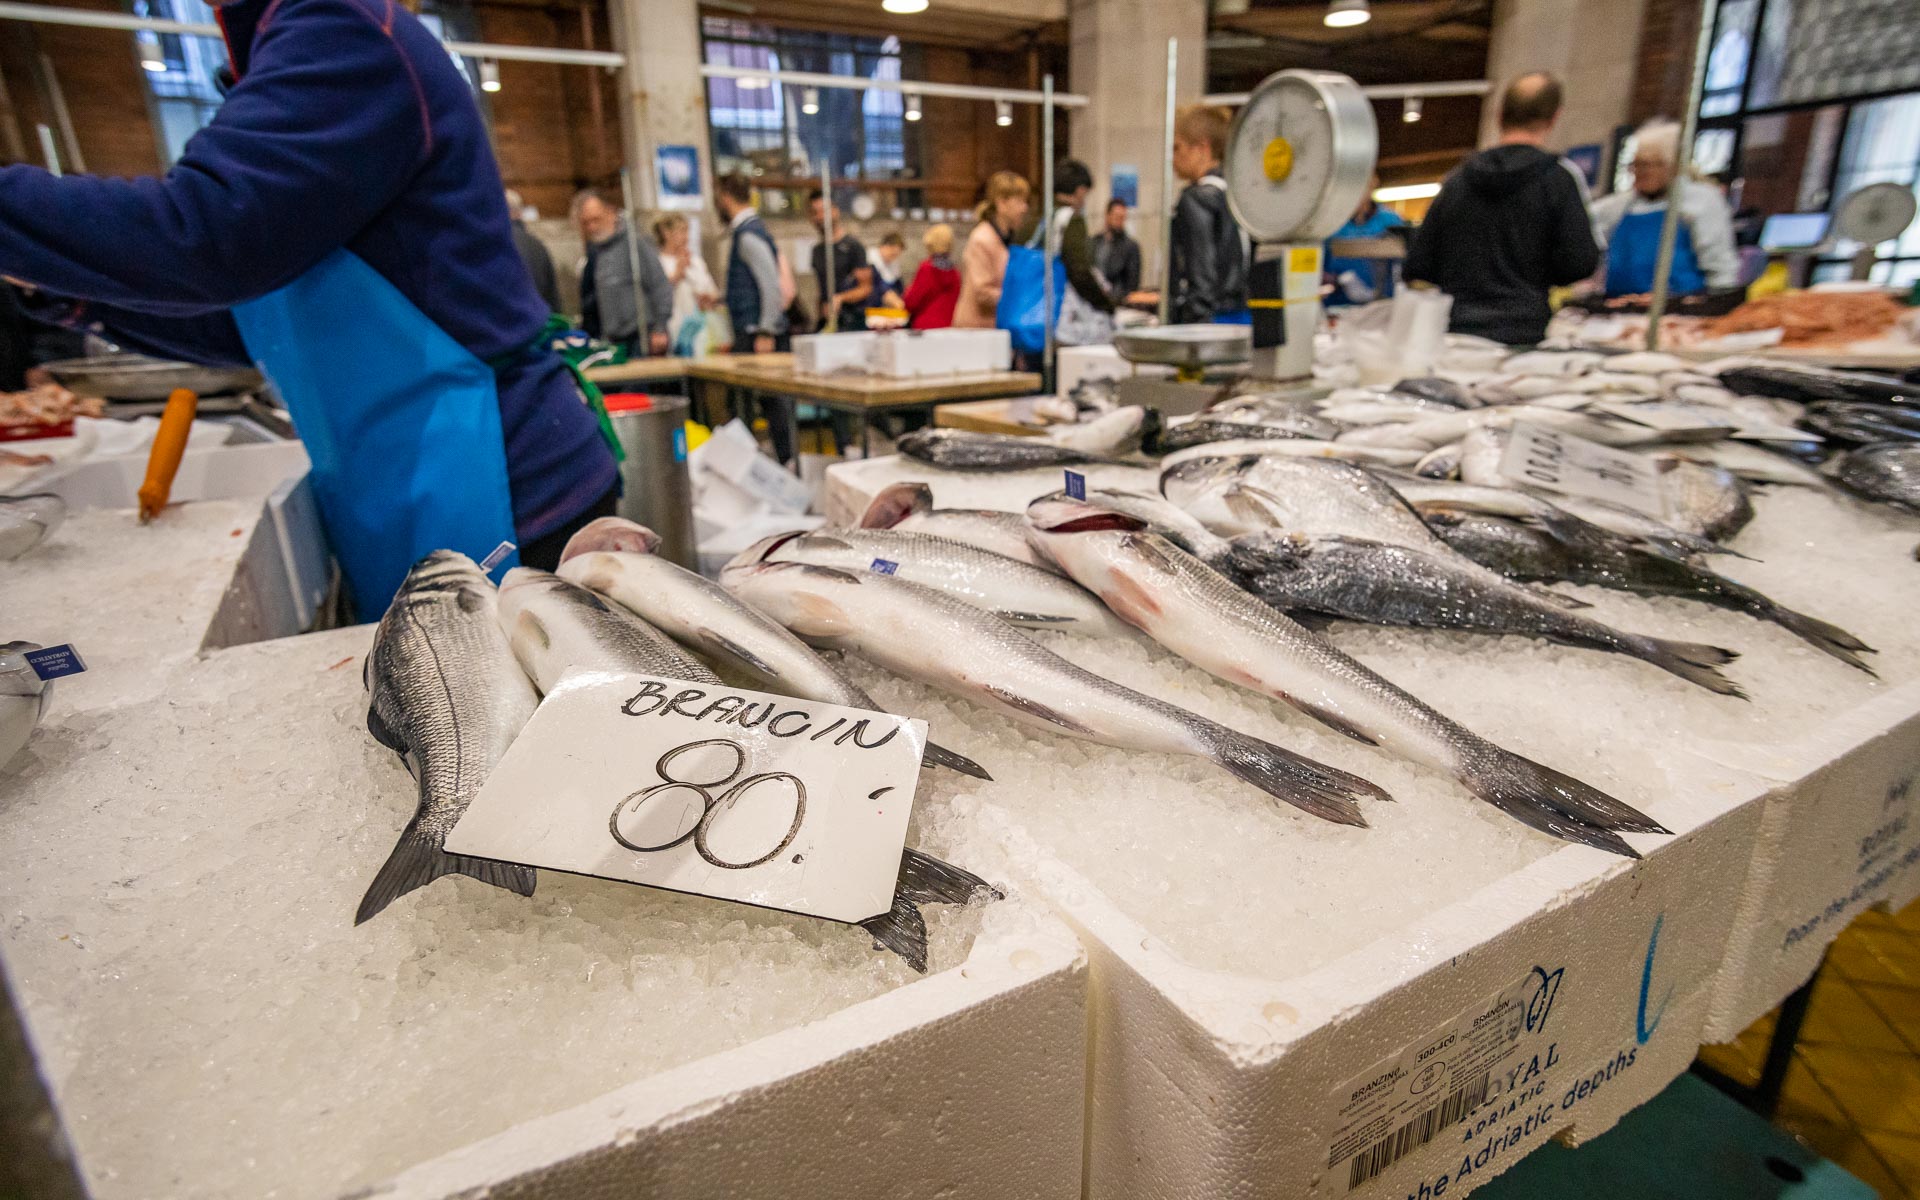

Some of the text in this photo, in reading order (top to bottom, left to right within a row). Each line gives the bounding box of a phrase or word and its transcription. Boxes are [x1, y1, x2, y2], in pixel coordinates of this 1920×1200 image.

[620, 680, 899, 749] BRANCIN
[1455, 1104, 1554, 1184] Adriatic
[1562, 1048, 1638, 1110] depths
[1463, 1080, 1546, 1144] ADRIATIC
